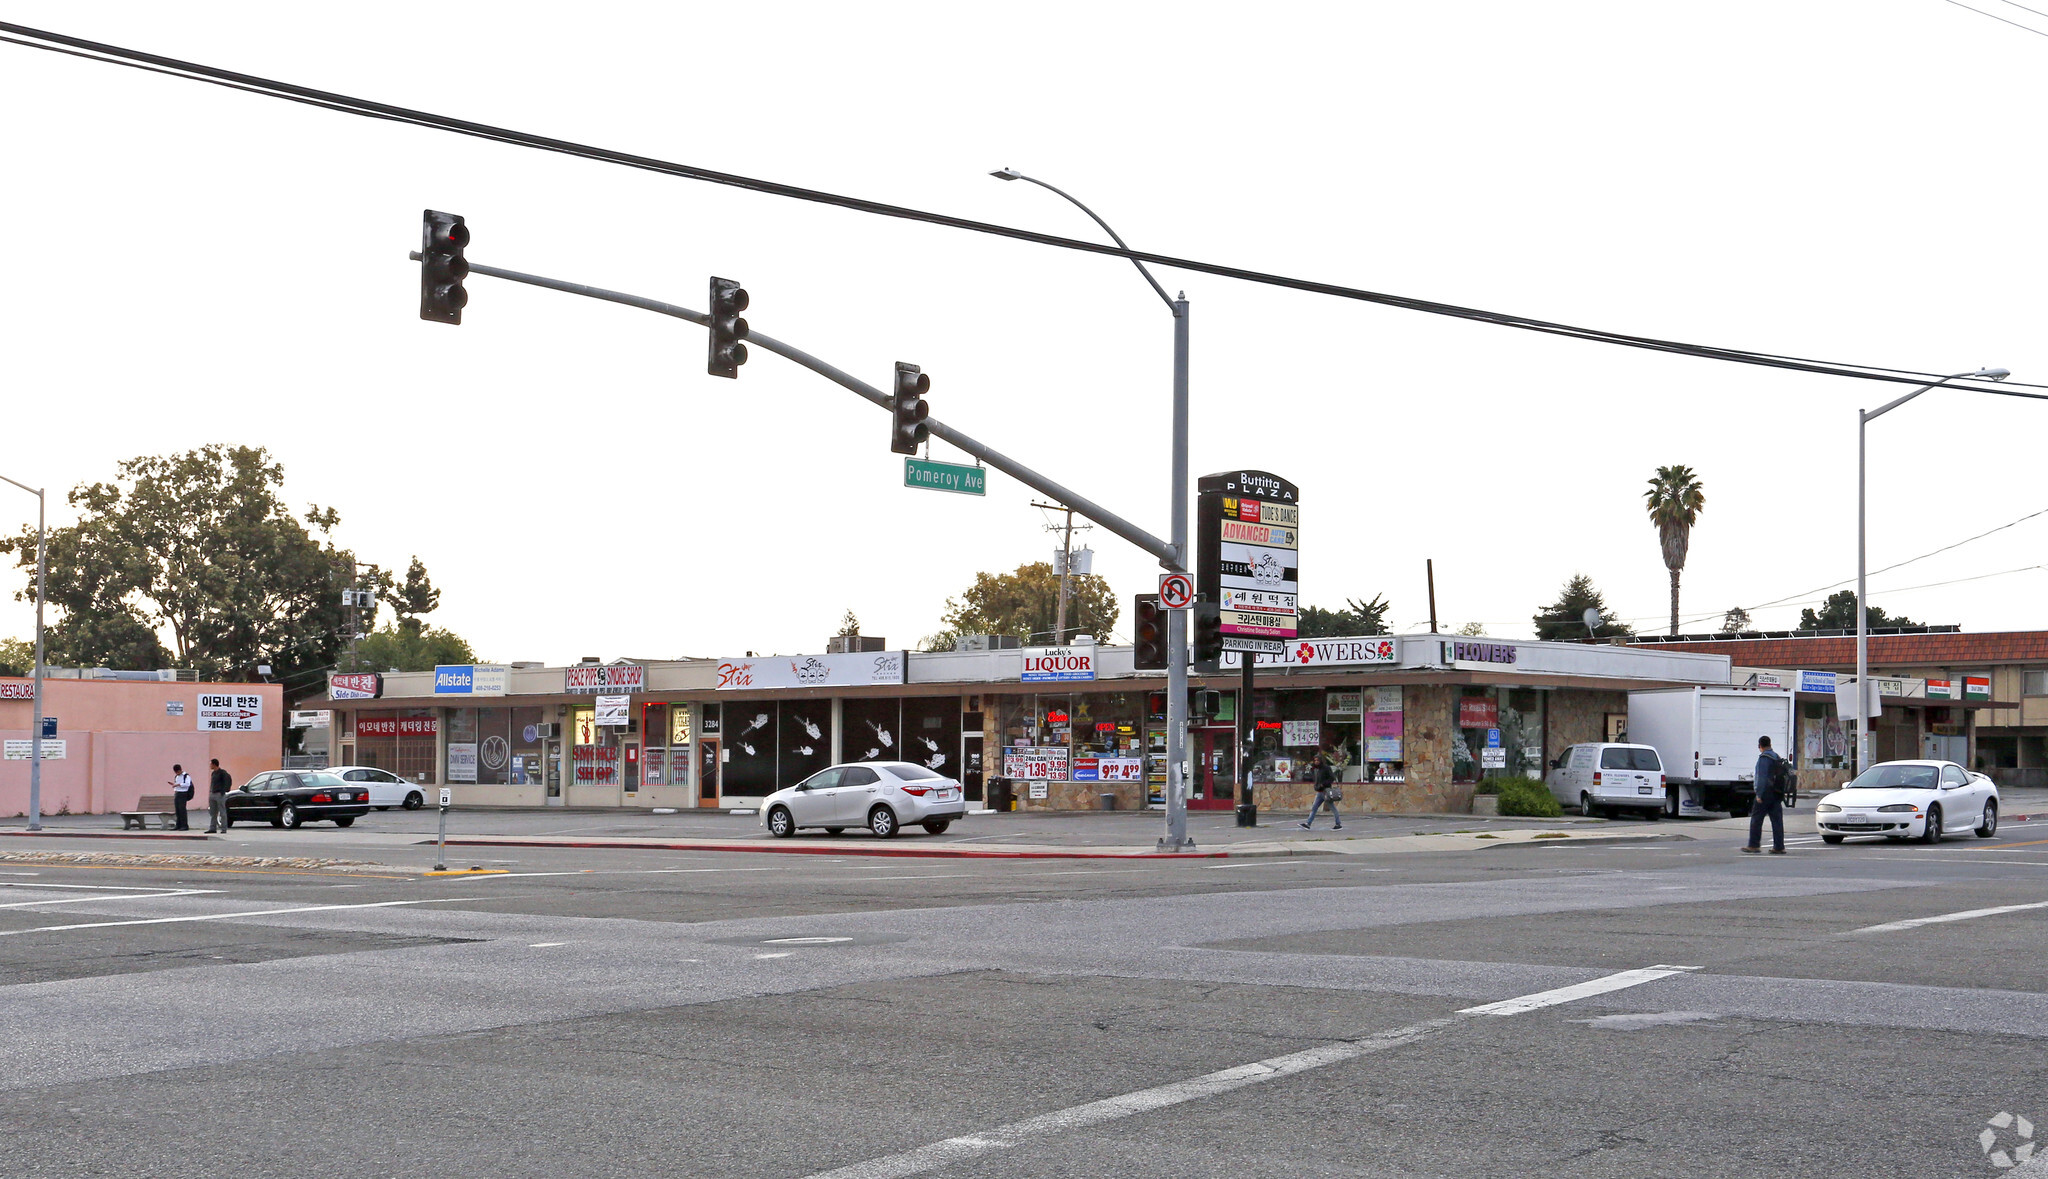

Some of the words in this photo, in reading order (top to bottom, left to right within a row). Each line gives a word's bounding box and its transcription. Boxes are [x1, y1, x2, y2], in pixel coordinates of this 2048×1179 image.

[908, 465, 959, 489] Pomeroy
[964, 473, 982, 488] Ave
[1241, 473, 1280, 489] Buttitta
[1227, 483, 1292, 499] PLAZA
[1223, 523, 1269, 542] ADVANCED
[1271, 529, 1286, 537] AUTO
[1270, 536, 1285, 544] CARE
[1224, 639, 1253, 649] PARKING
[1255, 641, 1262, 650] IN
[1264, 642, 1282, 651] REAR
[1045, 648, 1072, 657] Lucky's
[1456, 642, 1517, 663] FLOWERS
[804, 658, 822, 669] Stix
[874, 656, 898, 673] Stix
[1025, 656, 1090, 672] LIQUOR
[436, 673, 471, 686] Allstate
[568, 669, 584, 686] PEACE
[585, 668, 597, 685] PIPE
[607, 667, 626, 685] SMOKE
[627, 666, 642, 685] SHOP
[717, 663, 754, 688] Stix
[350, 675, 374, 691] 반찬
[336, 690, 349, 698] Side
[202, 696, 232, 707] 이모네
[237, 696, 258, 708] 반찬
[208, 720, 232, 729] 캐더링
[235, 721, 252, 729] 전문
[359, 721, 380, 732] 이모네
[381, 721, 395, 732] 반찬
[400, 721, 422, 732] 캐더링
[423, 720, 437, 732] 전문
[704, 720, 719, 728] 3284
[1096, 722, 1115, 731] OPEN
[1292, 732, 1319, 741] $14.99
[460, 754, 476, 764] SERVICE
[573, 746, 616, 763] SMOKE
[577, 767, 613, 781] SHOP
[1025, 762, 1046, 776] $1.39
